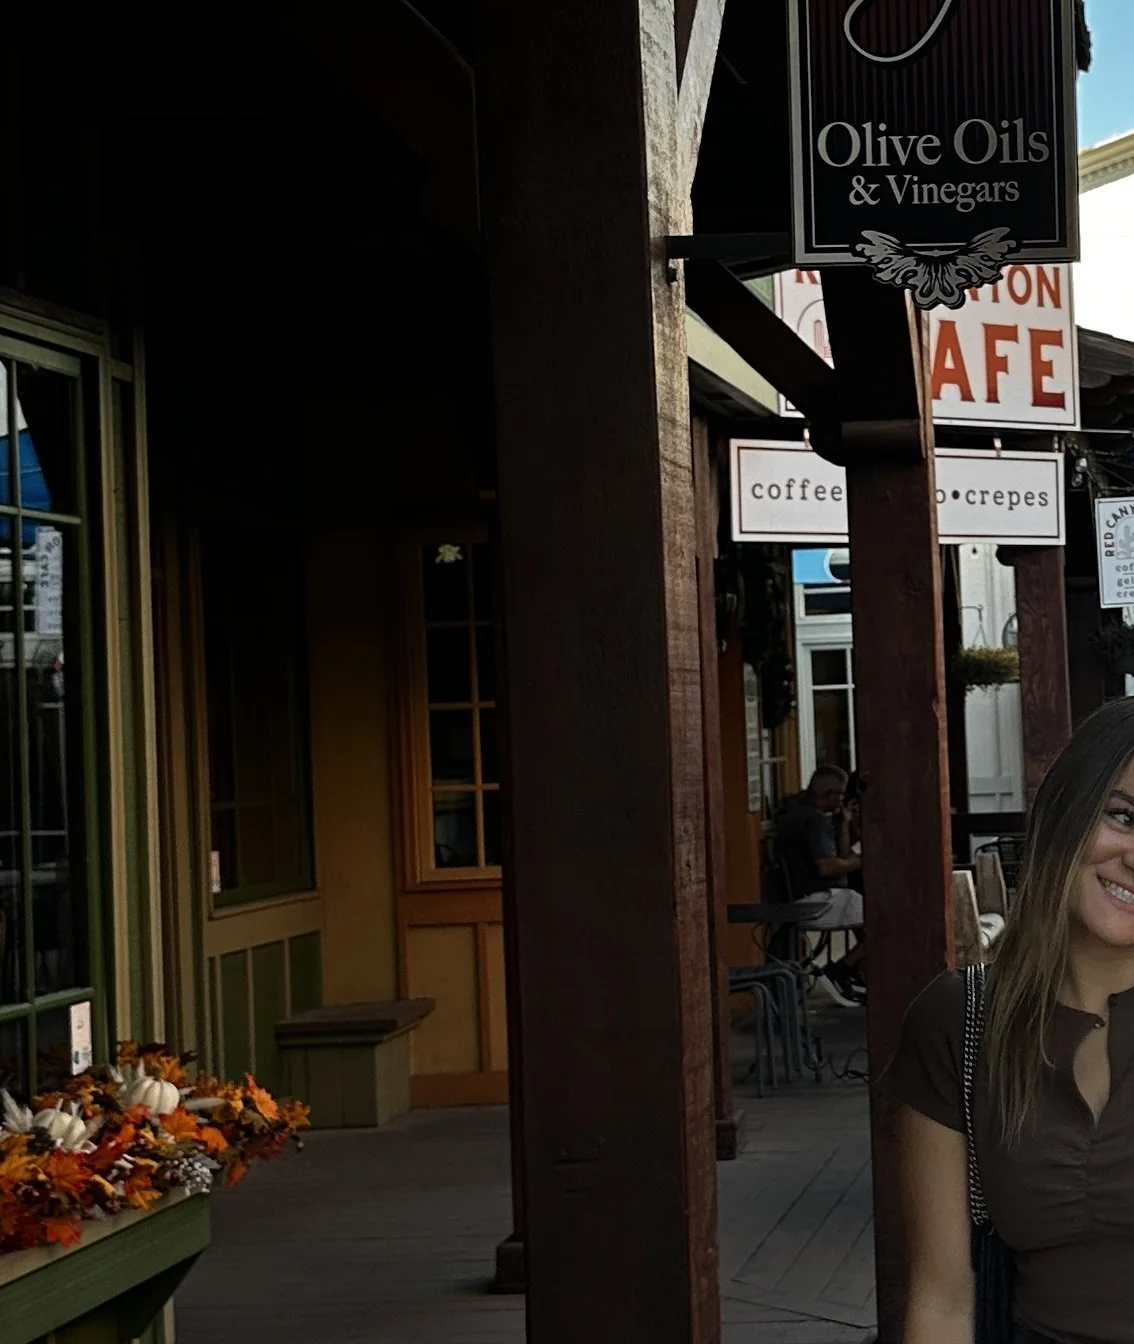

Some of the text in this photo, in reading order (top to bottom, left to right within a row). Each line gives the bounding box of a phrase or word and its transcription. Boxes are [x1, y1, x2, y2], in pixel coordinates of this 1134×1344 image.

[817, 117, 1050, 167] Olive Oils
[848, 173, 1020, 213] & Vinegars
[932, 319, 1066, 411] AFE
[751, 479, 843, 501] coffee
[965, 487, 1049, 511] crepes
[1103, 532, 1115, 558] RED
